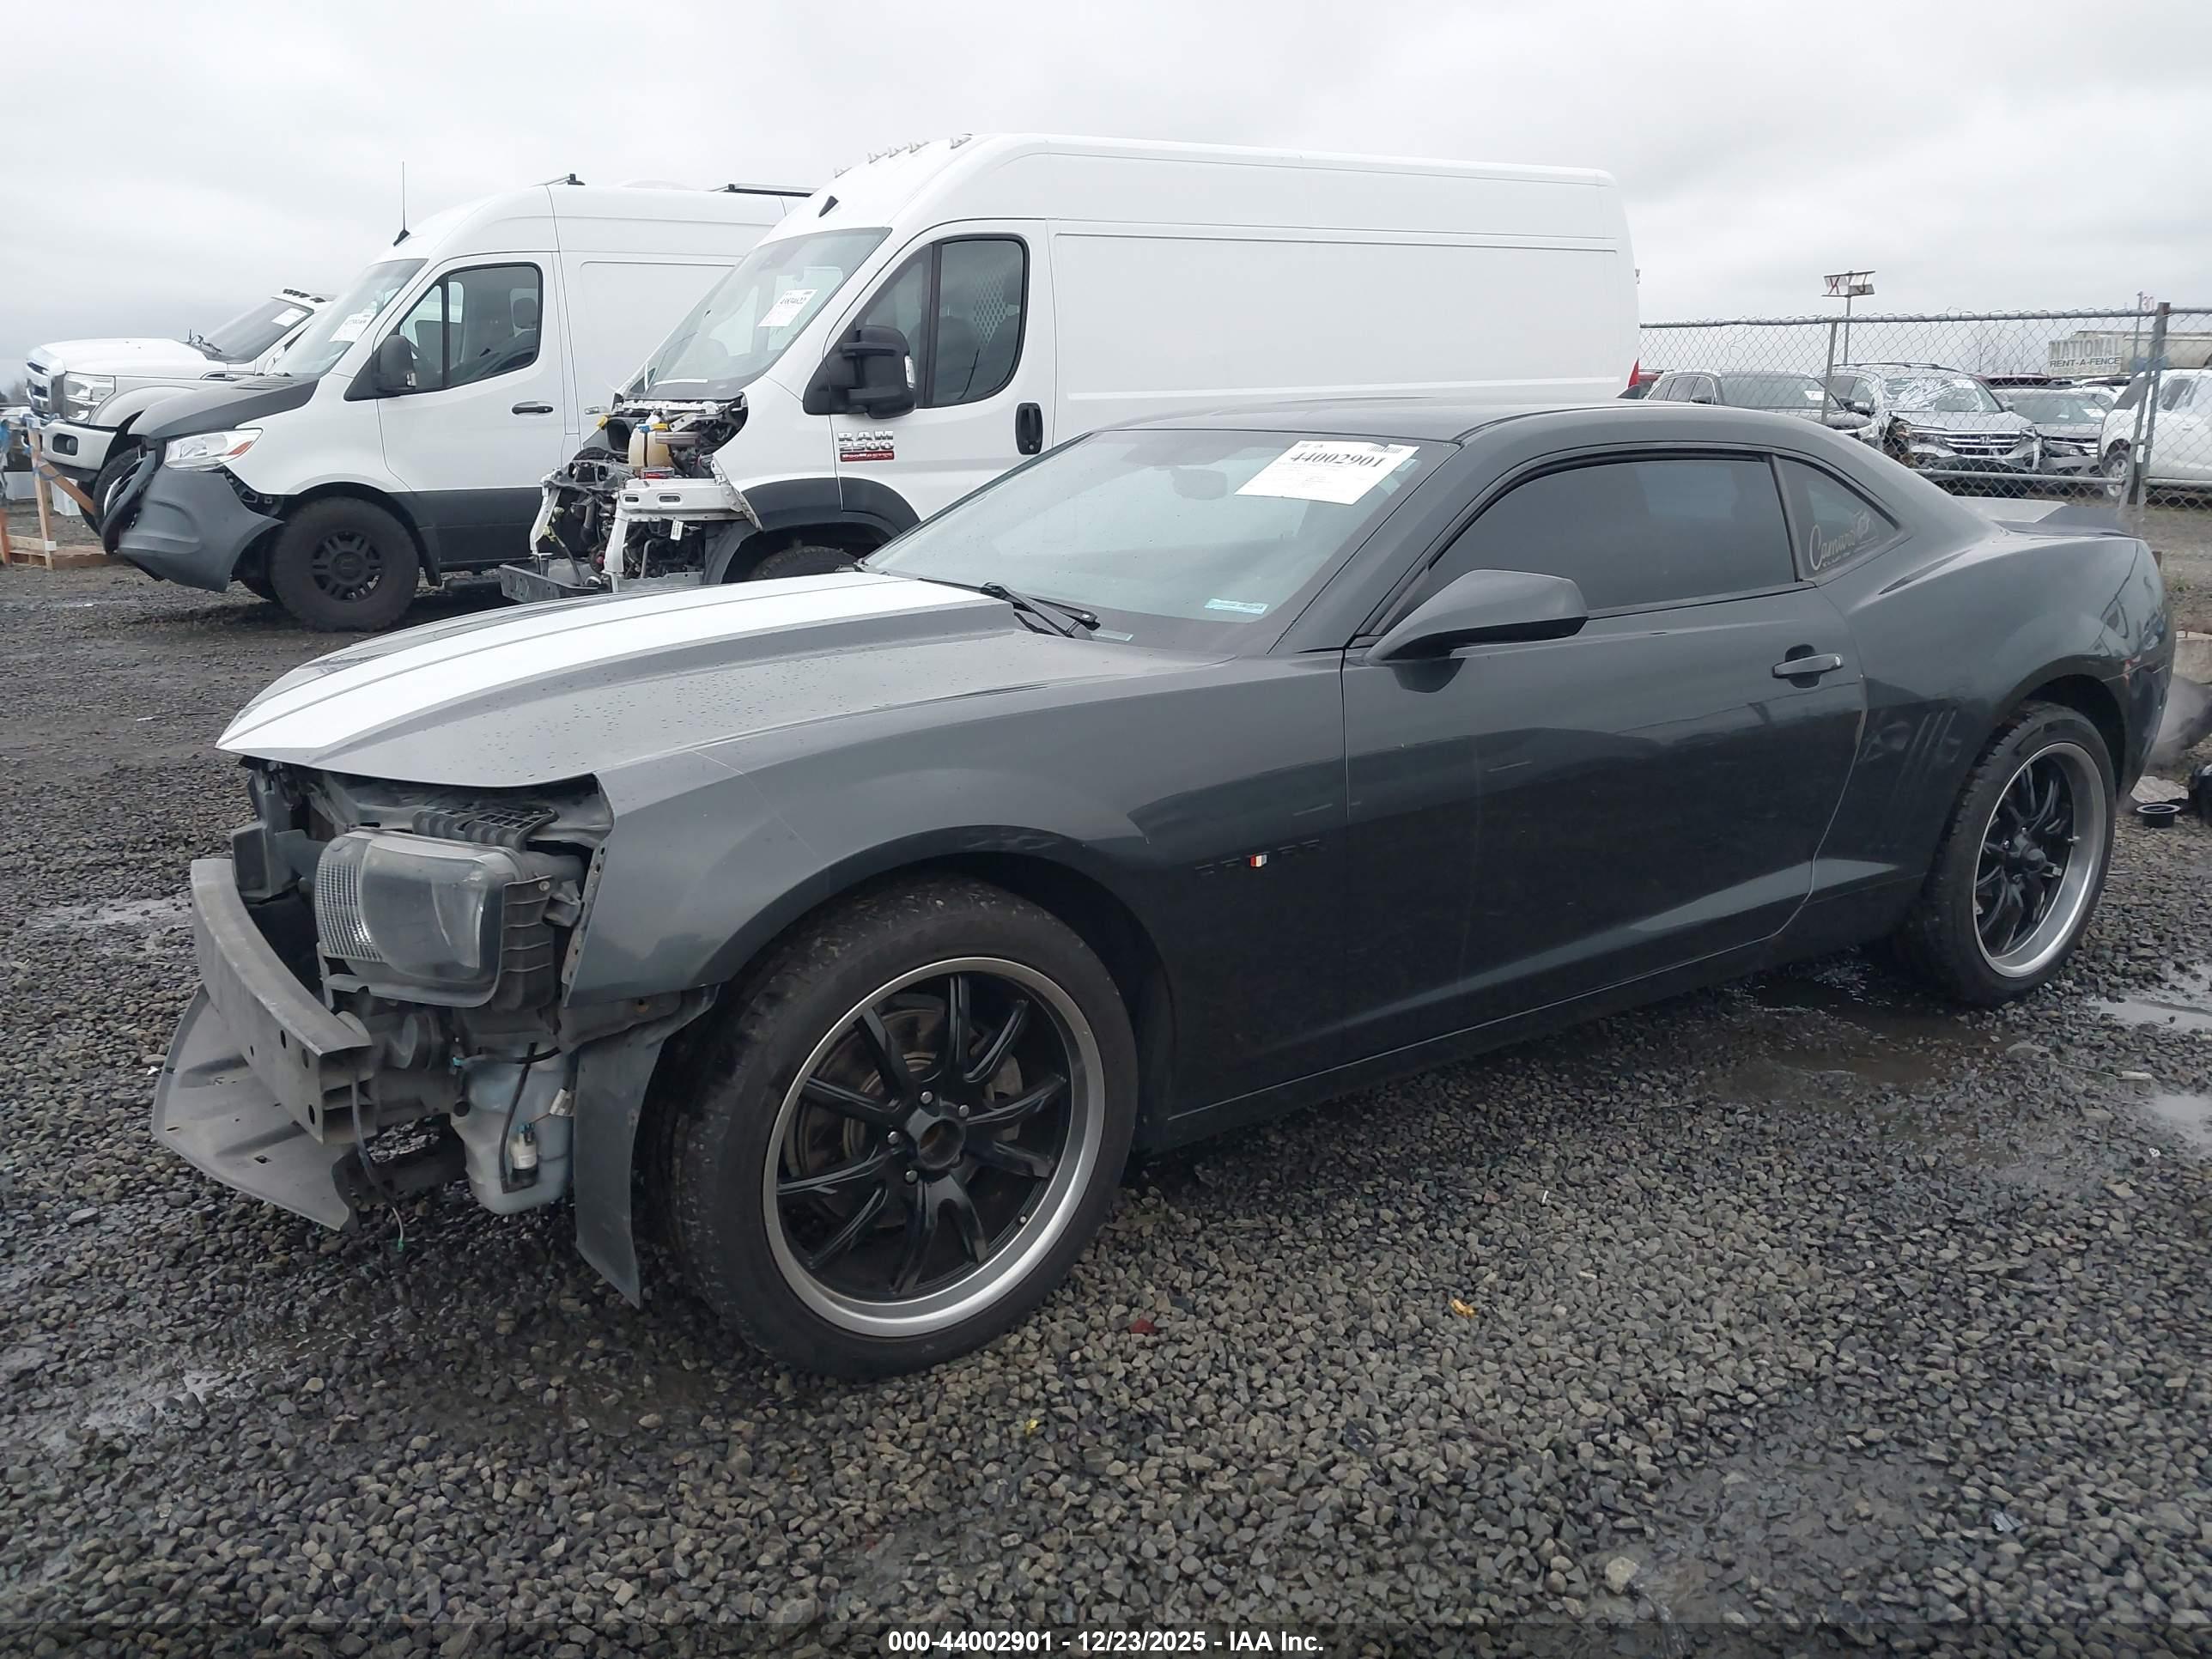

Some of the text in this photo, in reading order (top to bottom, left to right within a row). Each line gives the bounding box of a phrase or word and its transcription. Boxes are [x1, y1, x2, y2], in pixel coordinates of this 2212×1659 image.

[2049, 337, 2121, 358] NATIONAL
[2050, 357, 2121, 368] RENT-A-FENCE
[838, 430, 894, 441] RAM
[839, 441, 894, 452] 2500
[1290, 453, 1387, 466] 44002901
[1809, 524, 1856, 571] Camaro
